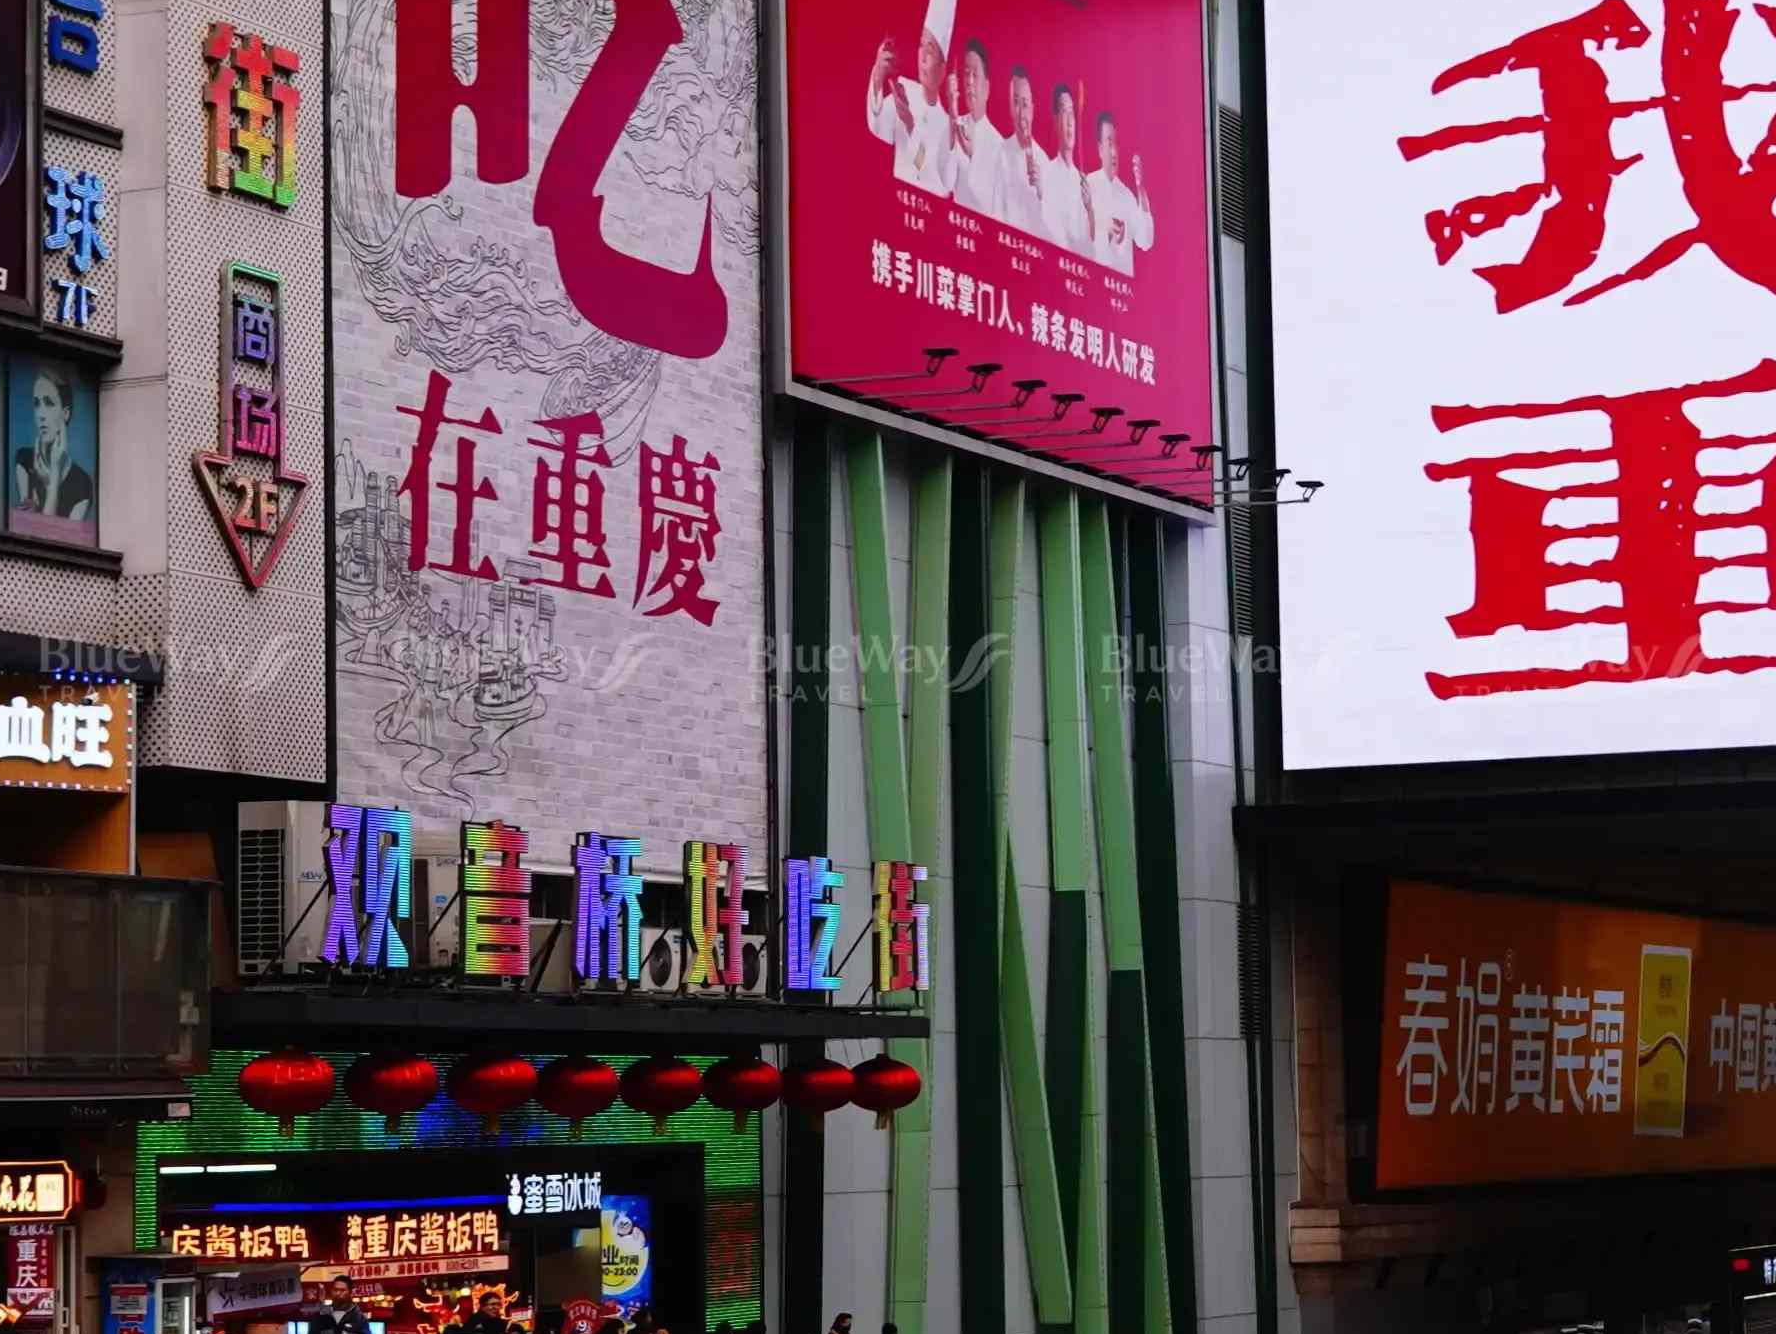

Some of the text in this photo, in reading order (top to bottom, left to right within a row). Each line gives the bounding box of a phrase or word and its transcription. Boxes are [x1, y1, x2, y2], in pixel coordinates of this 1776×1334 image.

[54, 277, 101, 325] 7F
[871, 238, 1156, 387] 携手川菜掌门人、辣条发明人研发
[232, 476, 278, 533] 2F
[396, 368, 722, 627] 在重慶
[322, 802, 930, 993] 观音桥好吃街
[524, 1172, 602, 1215] 蜜雪冰城
[364, 1209, 500, 1259] 重庆酱板鸭
[16, 1239, 39, 1287] 重庆
